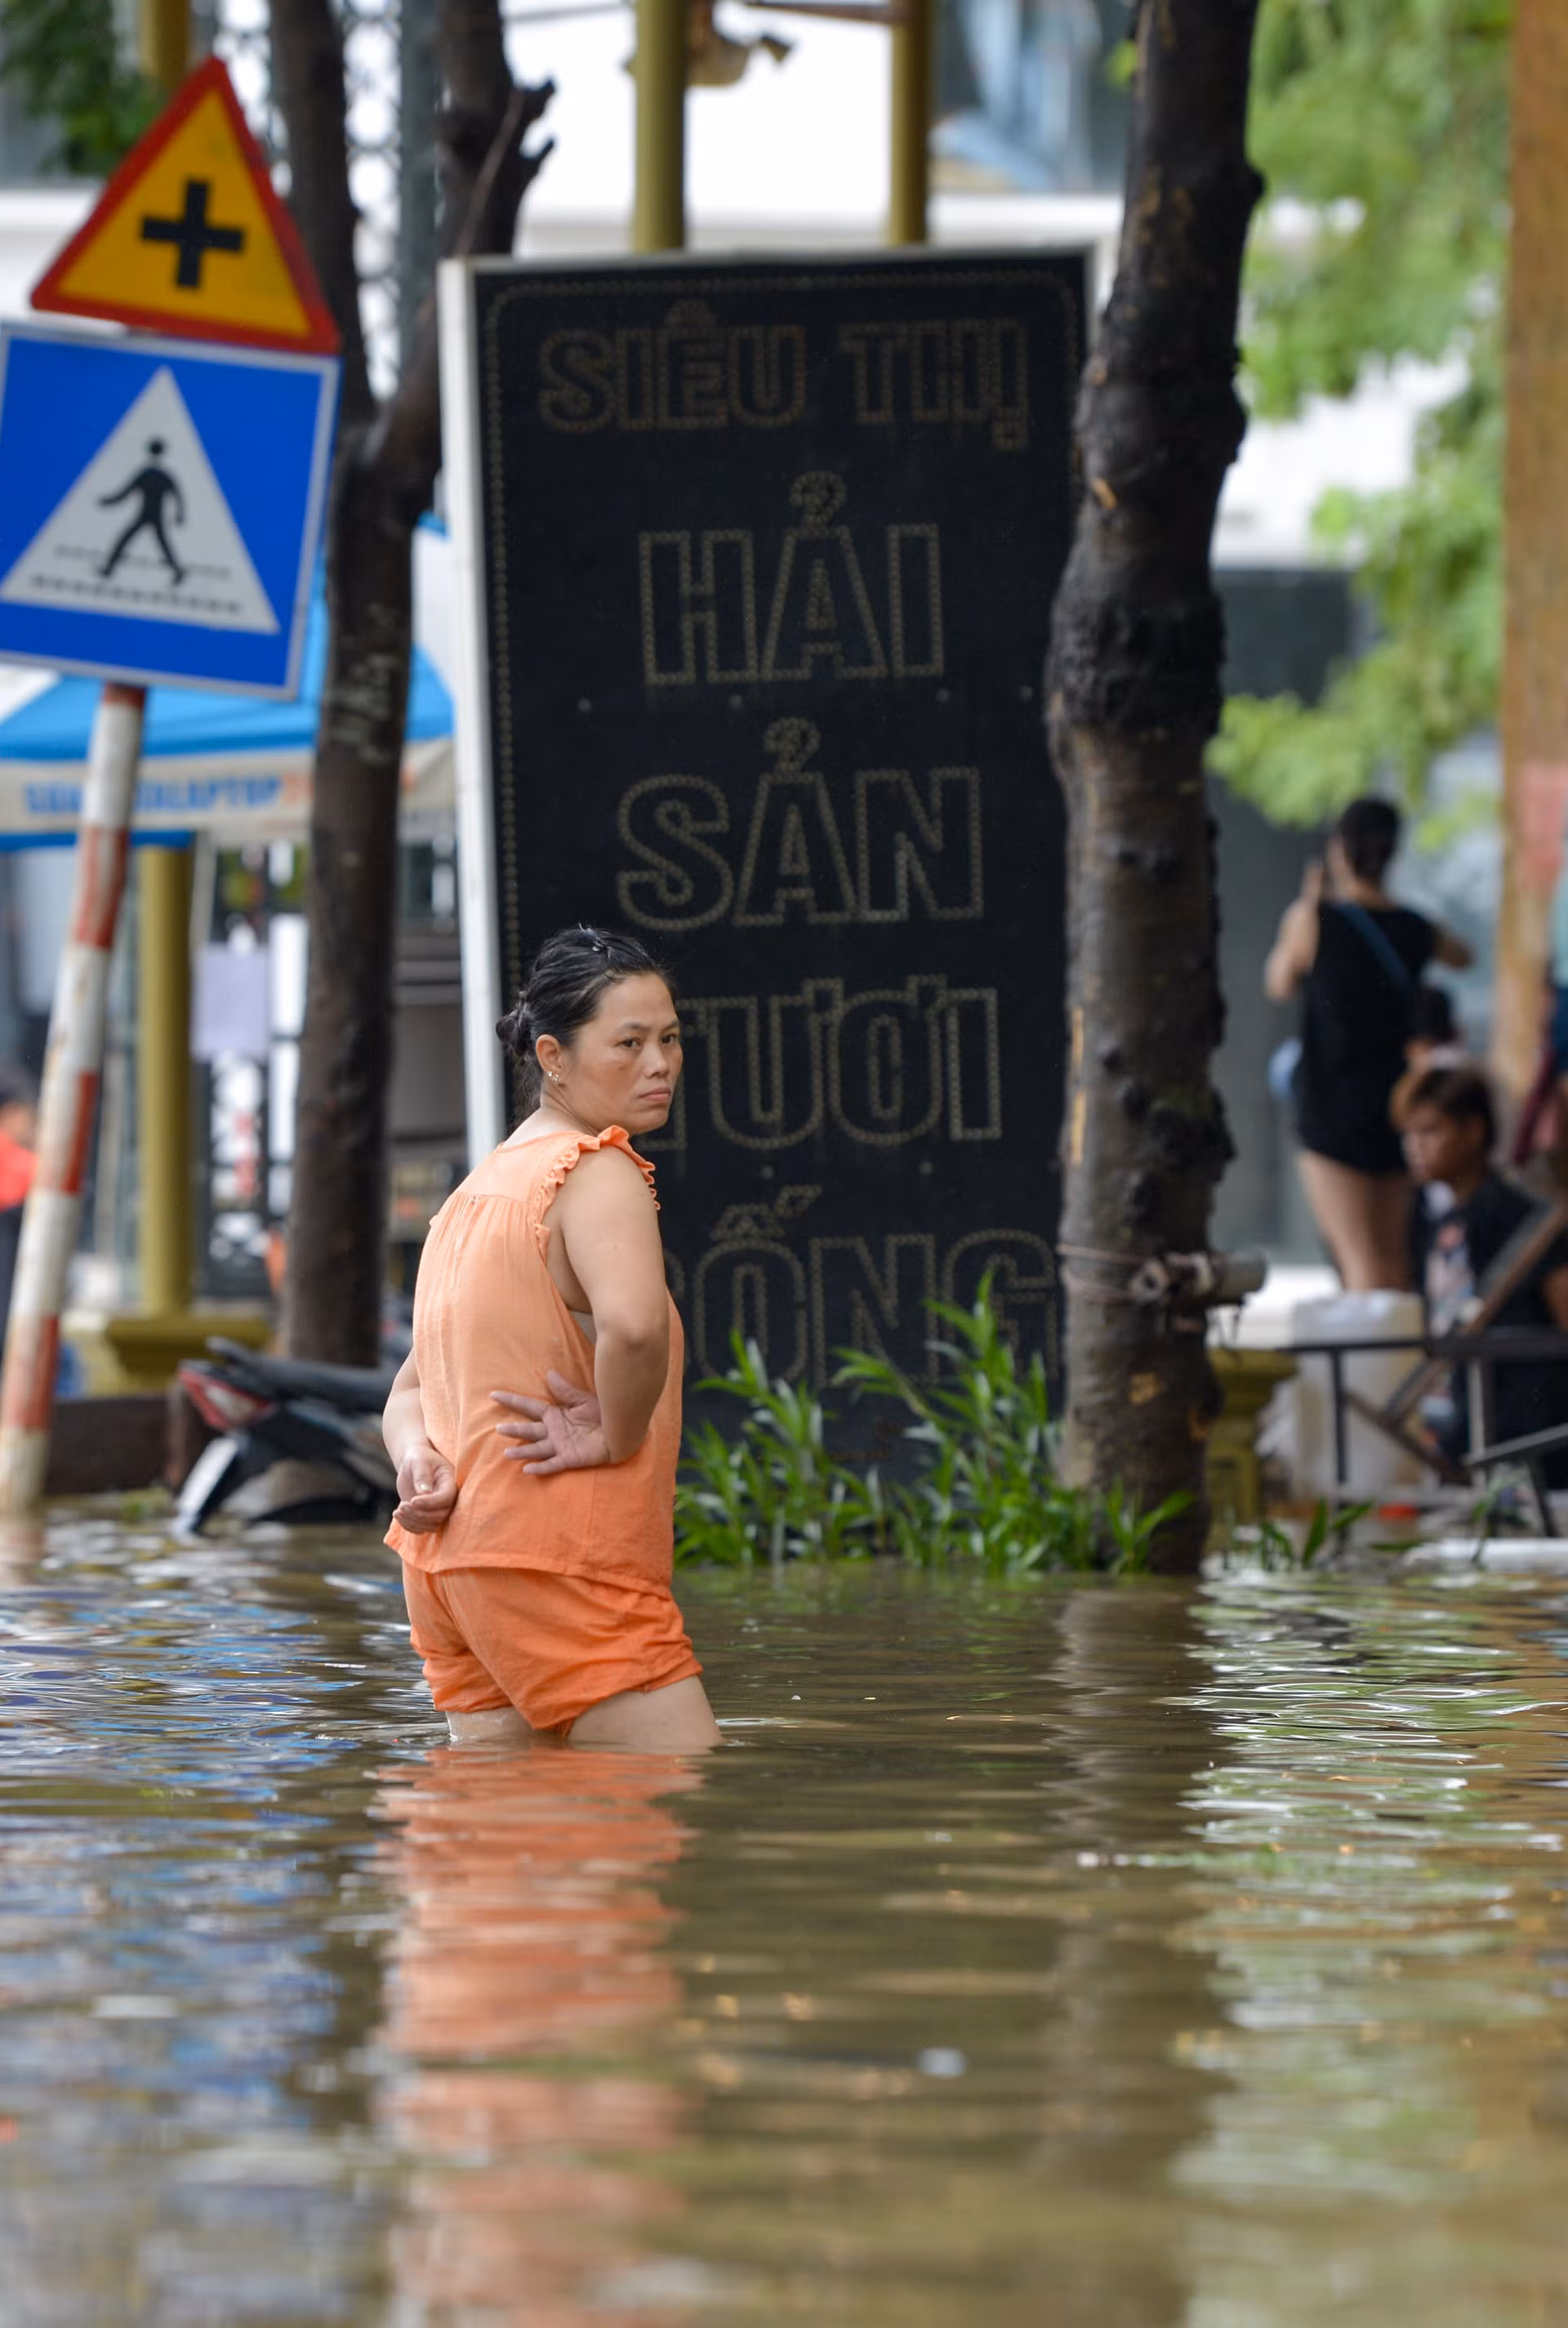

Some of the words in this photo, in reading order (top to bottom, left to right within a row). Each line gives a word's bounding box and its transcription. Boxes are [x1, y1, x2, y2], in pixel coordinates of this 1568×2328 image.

[540, 299, 805, 431] SIÊU
[839, 319, 1029, 449] THỊ
[639, 470, 944, 685] HẢI
[616, 716, 985, 931] SẢN
[665, 1185, 1059, 1389] ỐNG
